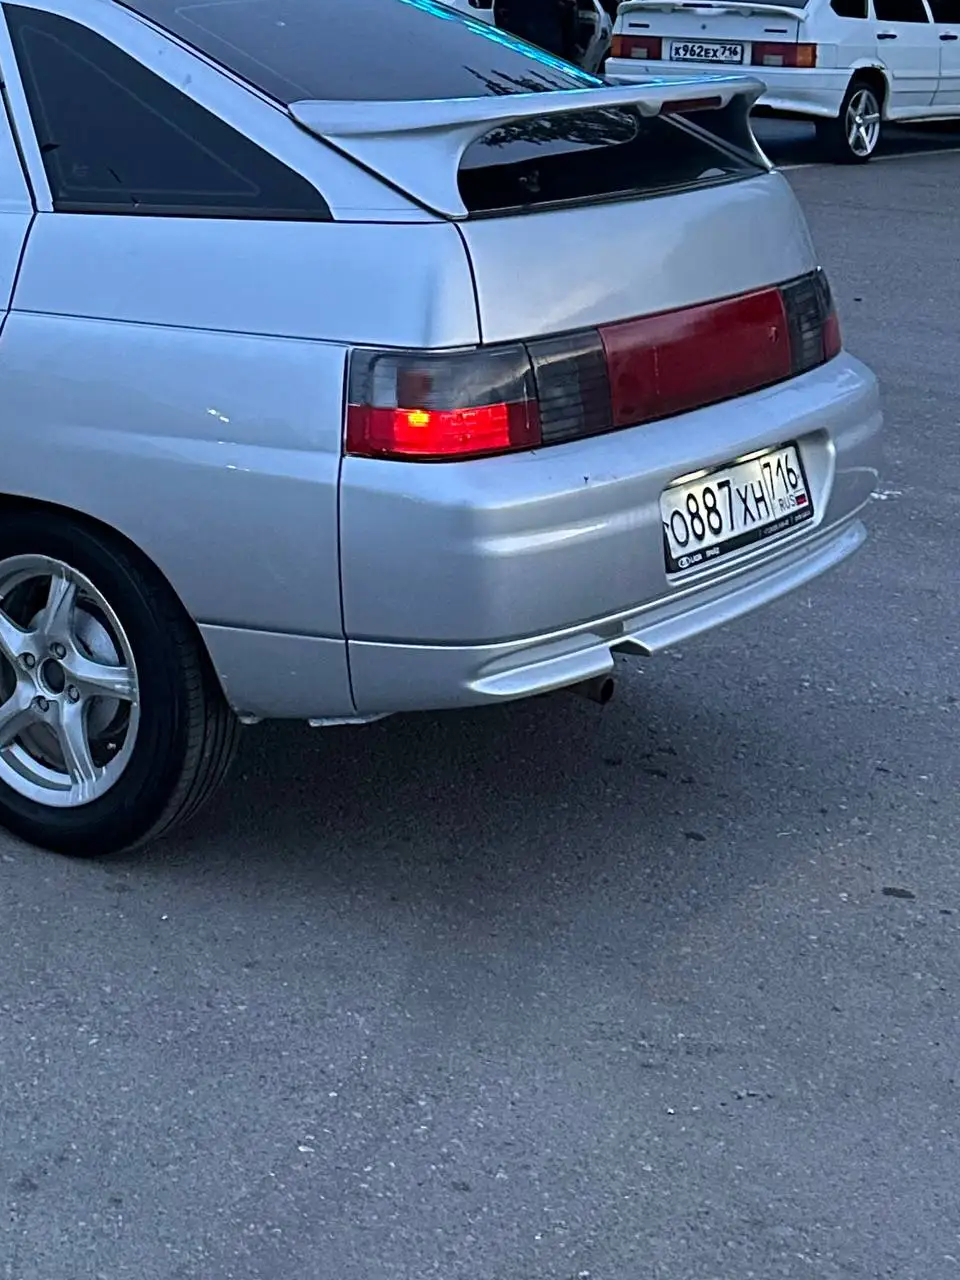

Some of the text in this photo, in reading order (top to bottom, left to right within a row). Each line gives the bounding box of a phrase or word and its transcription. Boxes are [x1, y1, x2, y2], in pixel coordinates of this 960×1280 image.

[720, 45, 739, 57] 716
[670, 453, 798, 547] О887ХН 716
[778, 494, 796, 512] RUS
